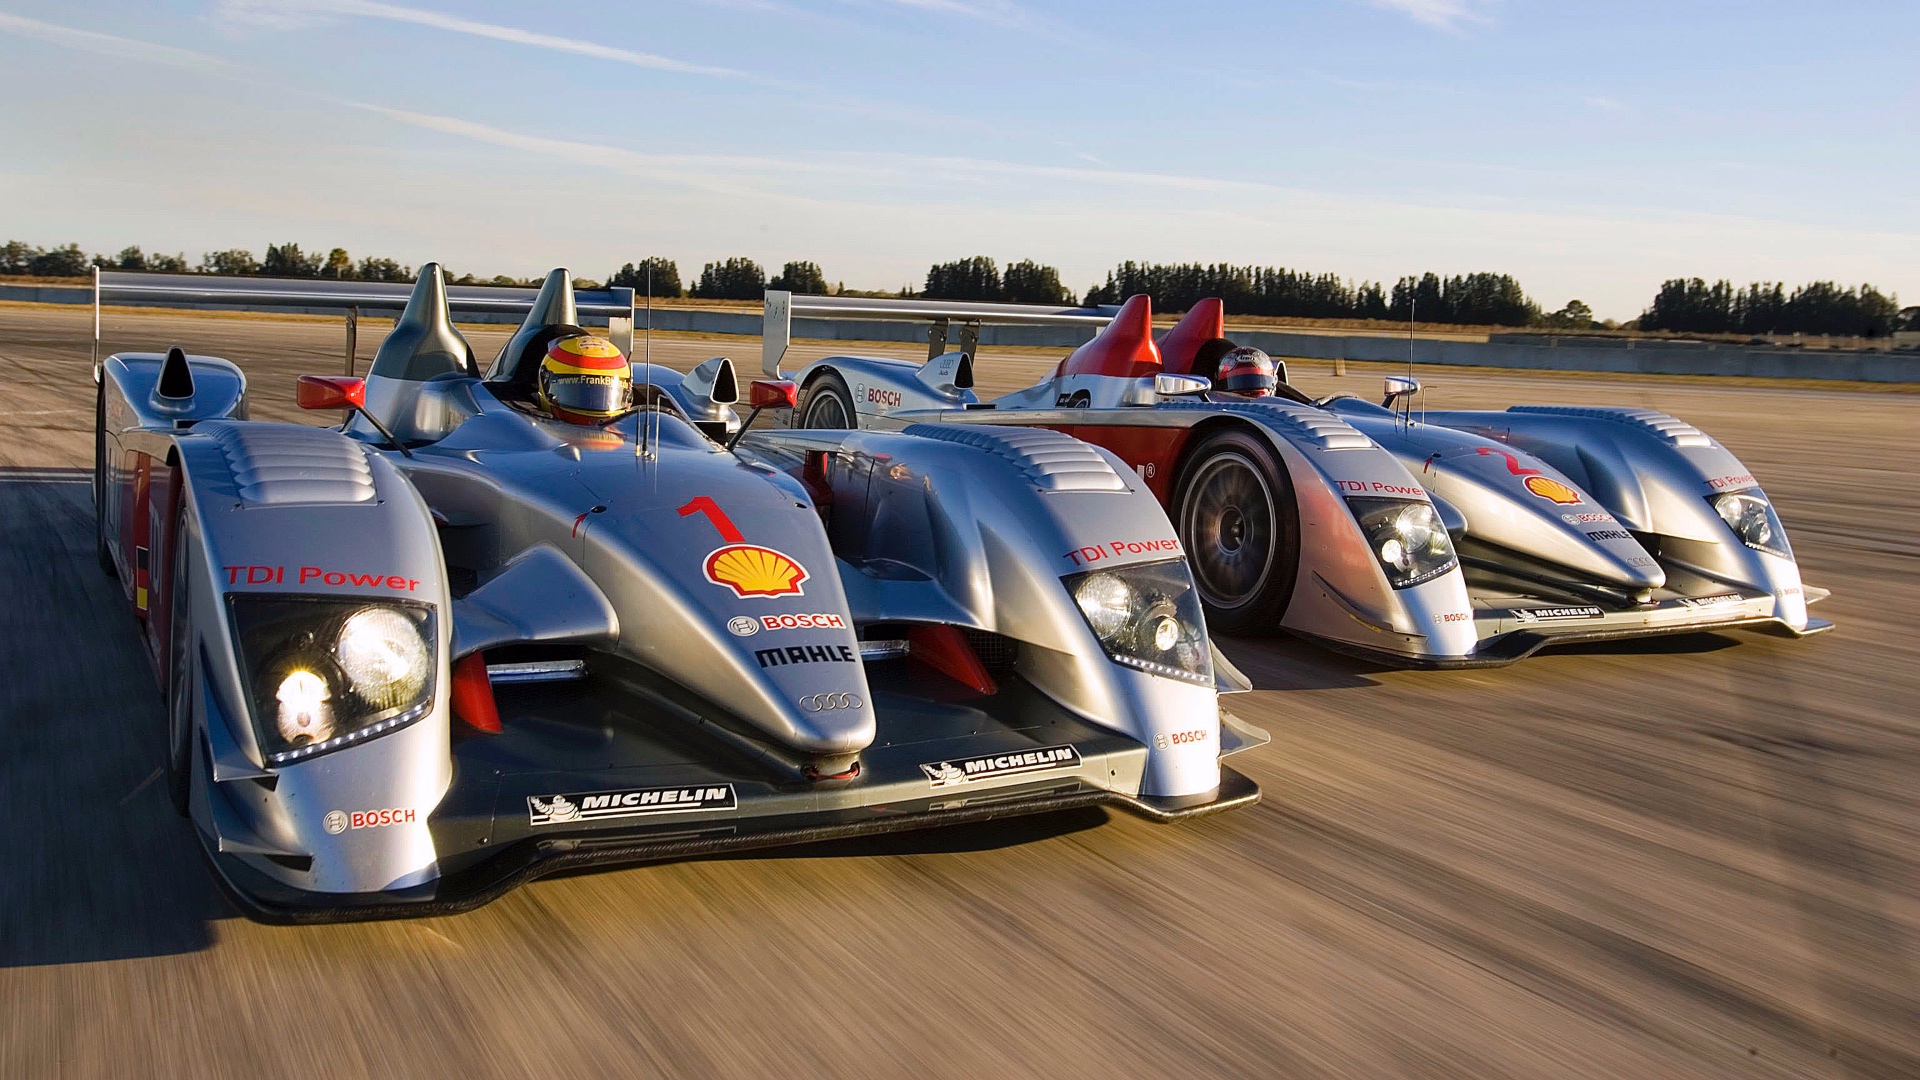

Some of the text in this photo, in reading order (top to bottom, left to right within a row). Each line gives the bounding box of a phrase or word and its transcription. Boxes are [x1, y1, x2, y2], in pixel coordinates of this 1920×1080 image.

[868, 388, 902, 407] BOSCH
[1475, 446, 1543, 476] 2
[1335, 480, 1425, 496] TDI Power
[676, 496, 746, 543] 1
[1578, 513, 1617, 523] BOSCH
[1586, 530, 1633, 541] MAHLE
[1062, 539, 1179, 566] TDI Power
[223, 565, 420, 592] TDI Power
[1444, 613, 1469, 622] BOSCH
[1534, 607, 1600, 617] MICHELIN
[762, 614, 845, 630] BOSCH
[754, 645, 856, 668] MAHLE
[1171, 730, 1208, 745] BOSCH
[965, 748, 1073, 774] MICHELIN
[581, 787, 727, 810] MICHELIN
[352, 808, 416, 828] BOSCH
